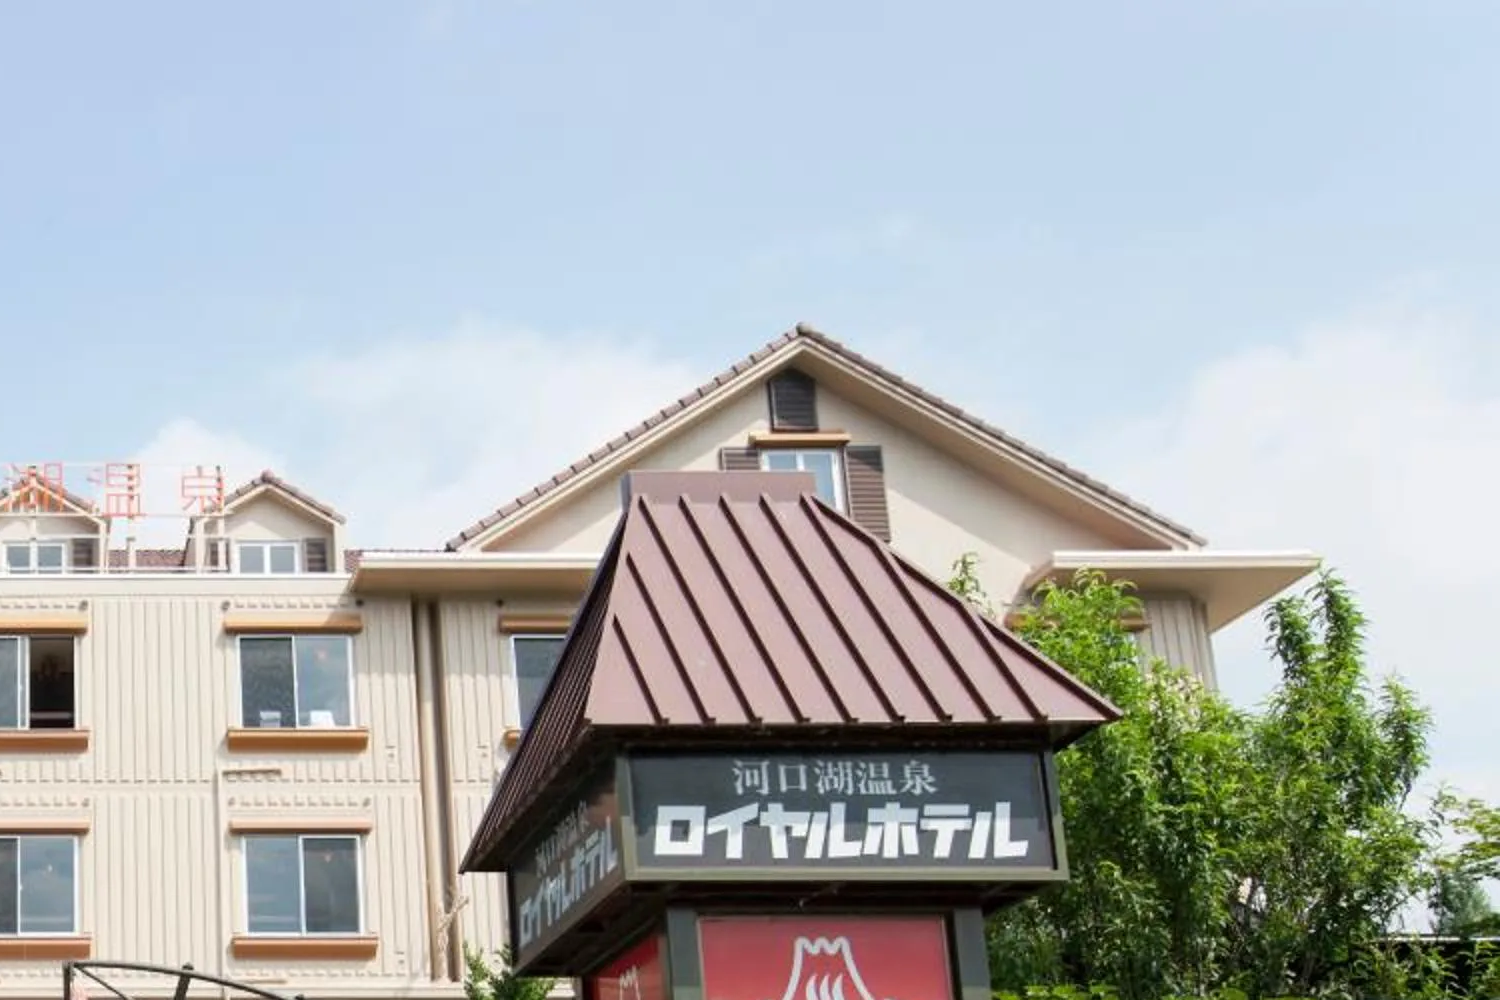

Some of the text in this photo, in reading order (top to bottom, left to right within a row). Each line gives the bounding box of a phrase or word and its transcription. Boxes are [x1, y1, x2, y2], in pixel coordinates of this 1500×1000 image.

[732, 758, 937, 797] 河口湖温泉
[653, 801, 1029, 859] ロイヤルホテル
[520, 815, 619, 948] ロイヤルホテル
